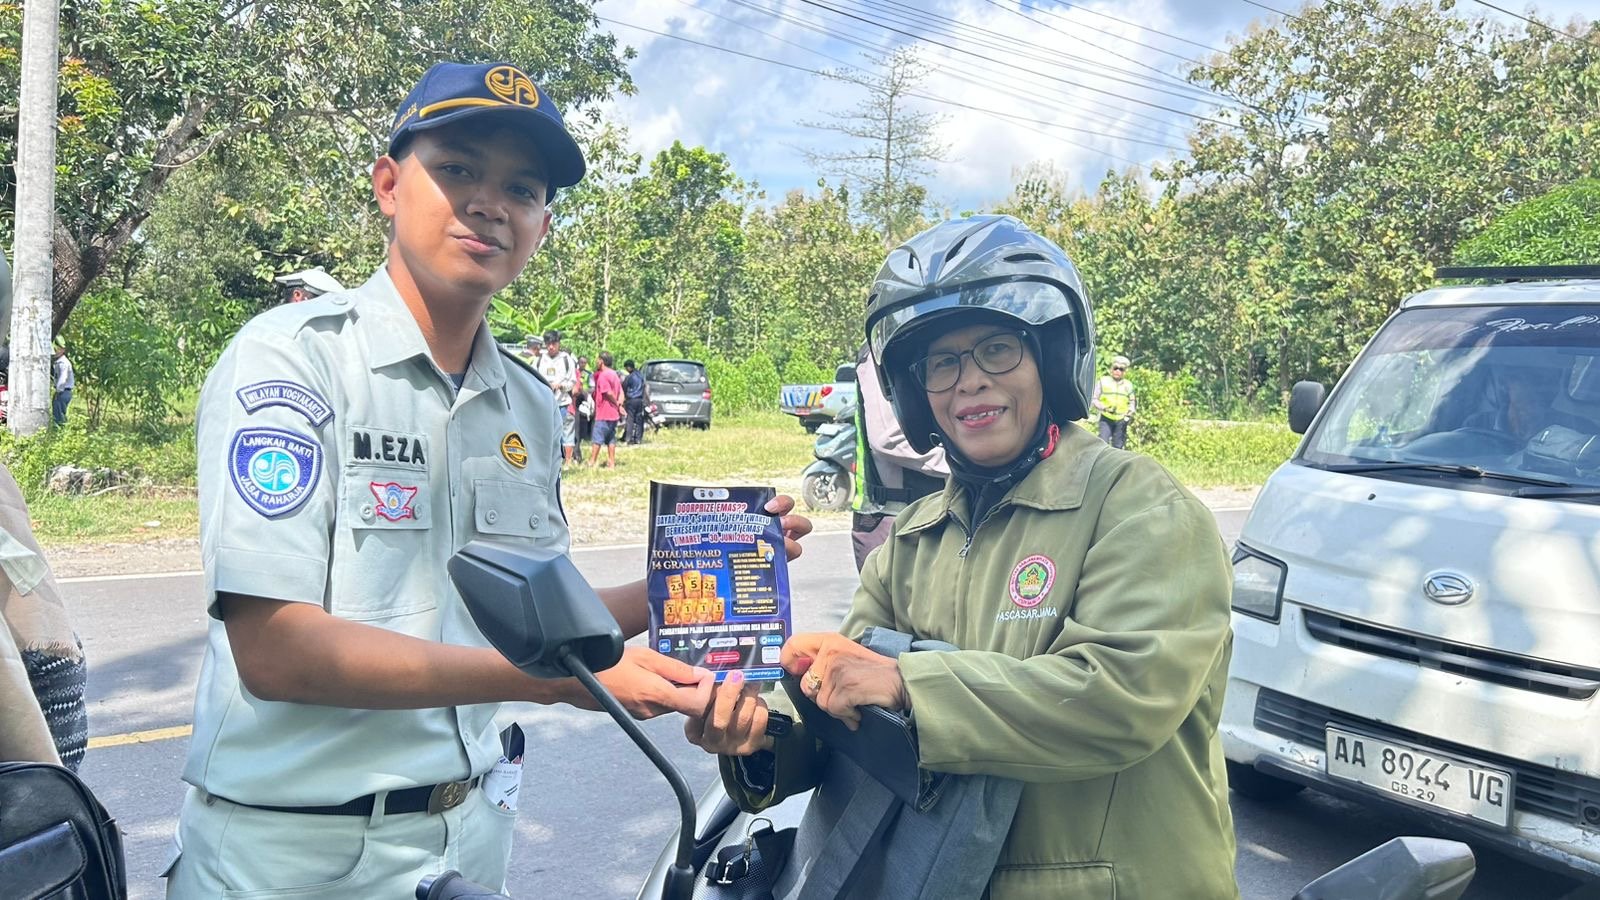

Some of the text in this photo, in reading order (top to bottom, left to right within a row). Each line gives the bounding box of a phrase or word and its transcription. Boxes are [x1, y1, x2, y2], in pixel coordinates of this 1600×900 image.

[246, 387, 324, 419] WILAYAH YOGYAKARTA
[243, 437, 313, 459] LANGKAH BAKTI
[353, 431, 426, 465] M.EZA
[240, 475, 305, 504] JASA RAHARJA
[676, 503, 748, 514] DOORPRIZE EMAS??
[656, 515, 676, 525] BAYAR
[729, 514, 747, 523] TEPAT
[748, 515, 771, 525] WAKTU
[666, 524, 719, 537] BERKESEMPATAN
[720, 524, 742, 534] DAPAT
[679, 534, 701, 545] MARET
[709, 533, 719, 543] 30
[720, 533, 736, 543] JUNI
[736, 533, 755, 543] 2026
[652, 550, 681, 559] TOTAL
[683, 549, 722, 558] REWARD
[663, 560, 694, 569] GRAM
[696, 559, 724, 568] EMAS
[691, 580, 698, 589] 5
[1334, 736, 1504, 808] AA 8944 VG
